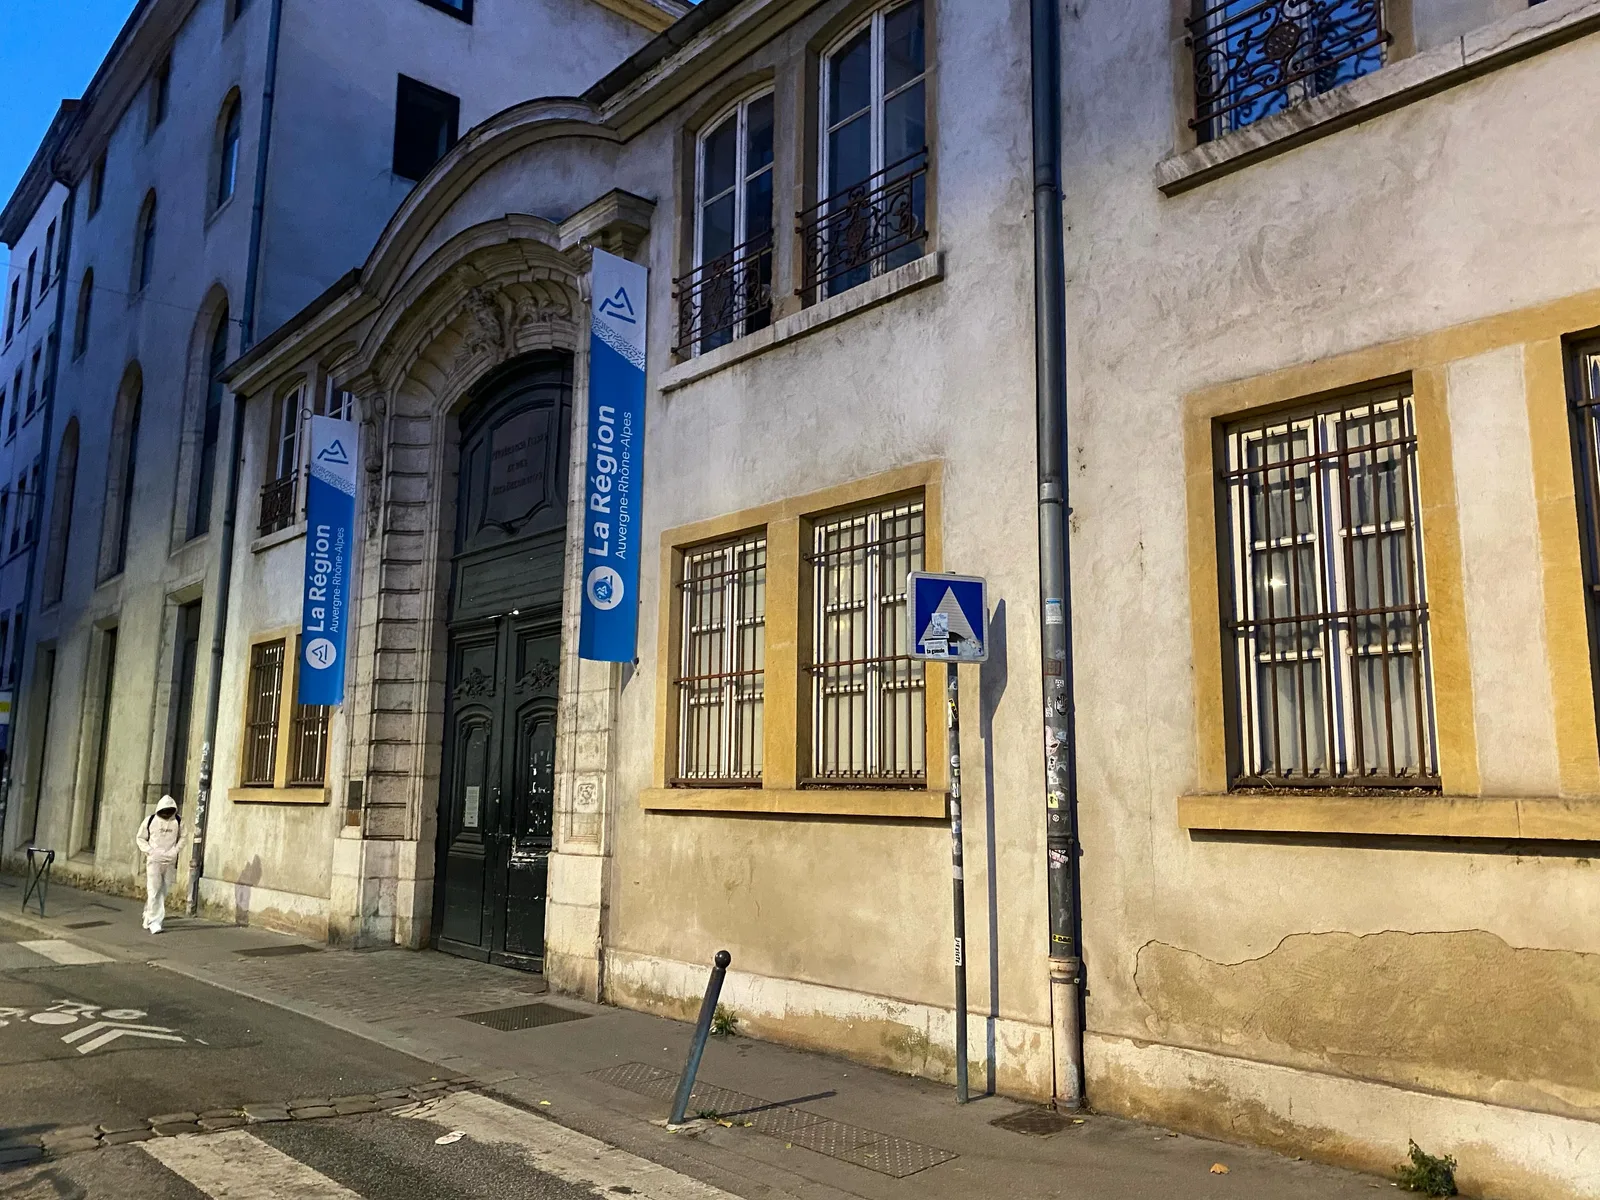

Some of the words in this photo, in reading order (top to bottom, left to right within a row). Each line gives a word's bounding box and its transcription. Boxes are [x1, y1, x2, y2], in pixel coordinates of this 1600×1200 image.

[590, 405, 618, 514] Région
[615, 411, 633, 560] Auvergne-Rhône-Alpes
[308, 524, 332, 602] Région
[330, 527, 345, 633] Auvergne-Rhône-Alpes
[588, 521, 610, 557] La
[306, 607, 325, 632] La
